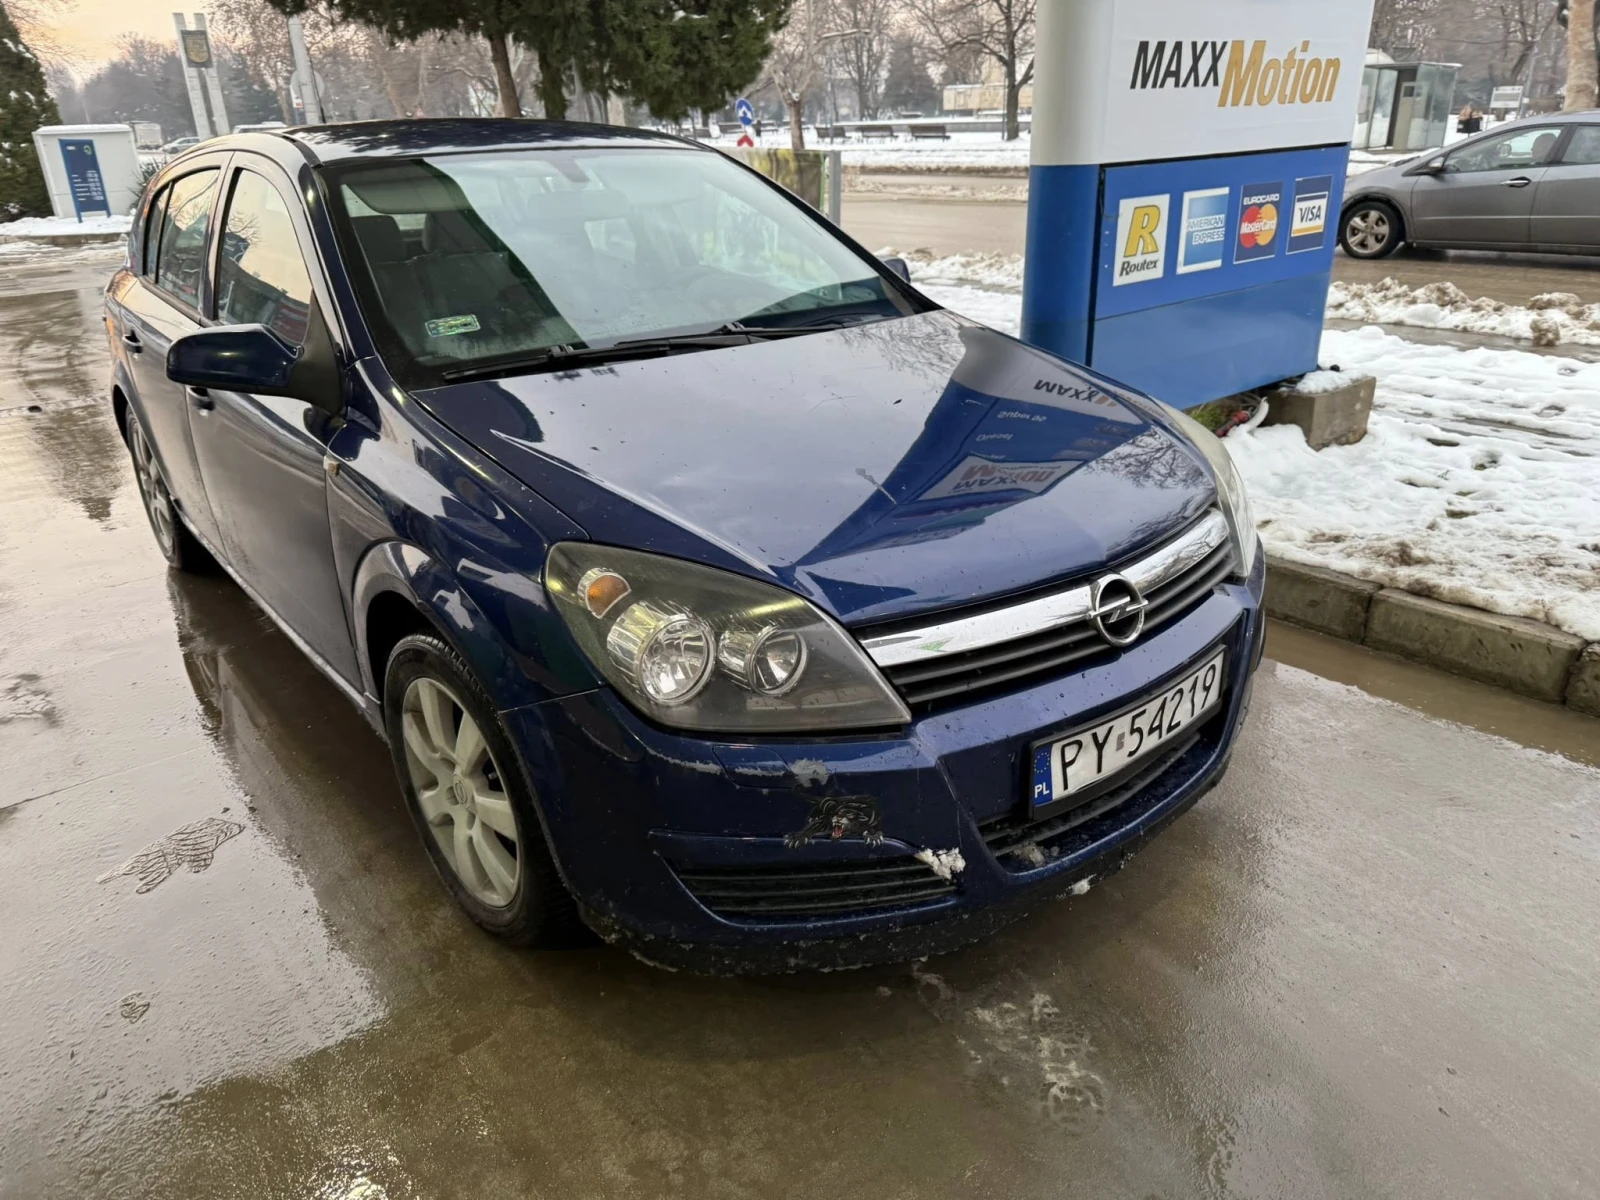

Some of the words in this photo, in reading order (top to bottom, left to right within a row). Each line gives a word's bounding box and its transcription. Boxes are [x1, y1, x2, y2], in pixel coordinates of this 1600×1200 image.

[1243, 193, 1280, 205] EUROCARD
[1299, 205, 1322, 223] VISA
[1123, 204, 1161, 258] R
[1187, 216, 1224, 231] AMERICAN
[1240, 219, 1277, 234] MasterCard
[1193, 229, 1225, 244] EXPRESS
[1119, 258, 1160, 277] Routex
[1060, 725, 1115, 791] PY
[1127, 663, 1217, 757] 54219
[1034, 783, 1050, 798] PL
